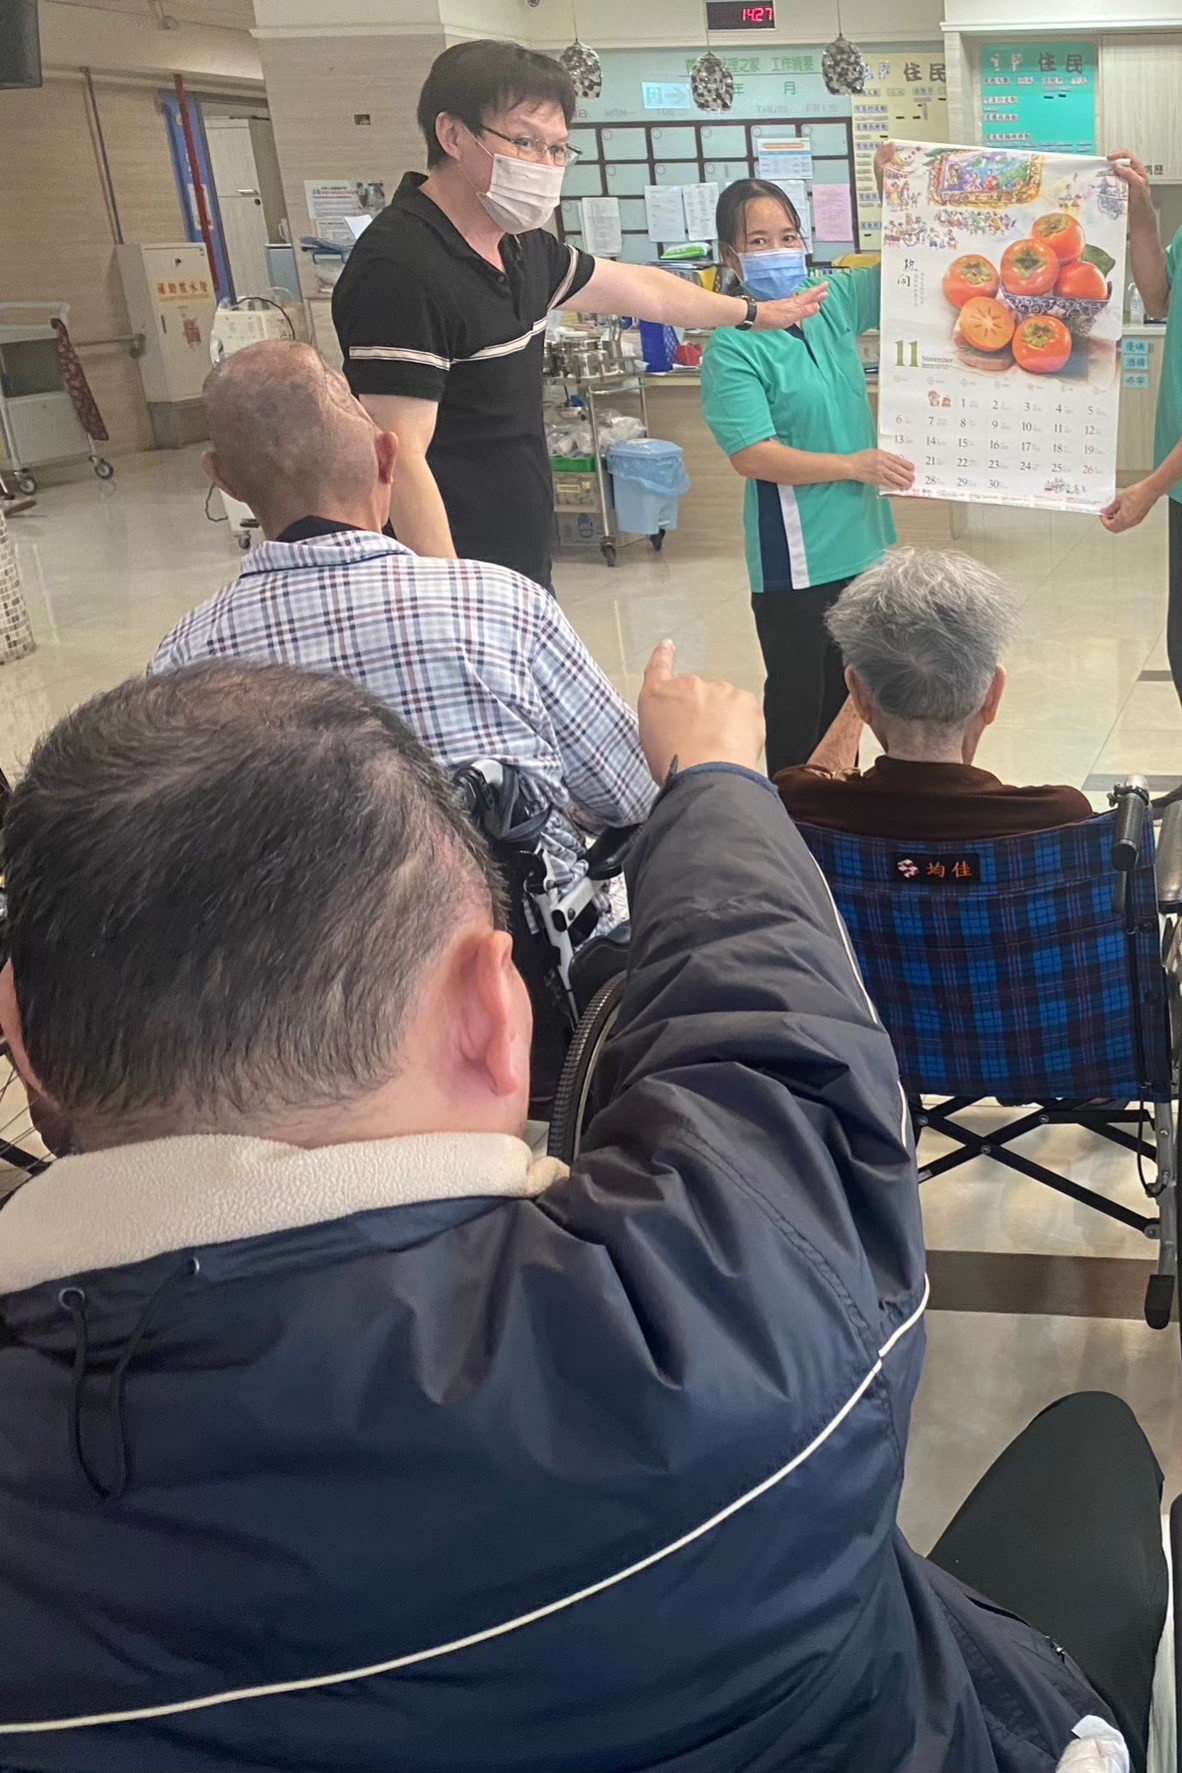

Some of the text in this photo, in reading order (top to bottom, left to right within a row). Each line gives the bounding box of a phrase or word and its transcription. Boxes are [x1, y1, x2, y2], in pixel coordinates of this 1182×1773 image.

[1038, 52, 1083, 74] 住民
[904, 63, 946, 82] 住民
[784, 81, 796, 95] 月
[894, 340, 953, 367] 11 November
[1022, 422, 1032, 431] 10
[1054, 423, 1062, 433] 11
[1085, 425, 1095, 435] 12
[895, 434, 1095, 454] 13 14 15 16 17 18 19
[925, 456, 1094, 474] 21 22 23 24 25 26
[924, 475, 999, 489] 28 29 30
[926, 861, 973, 878] 均佳
